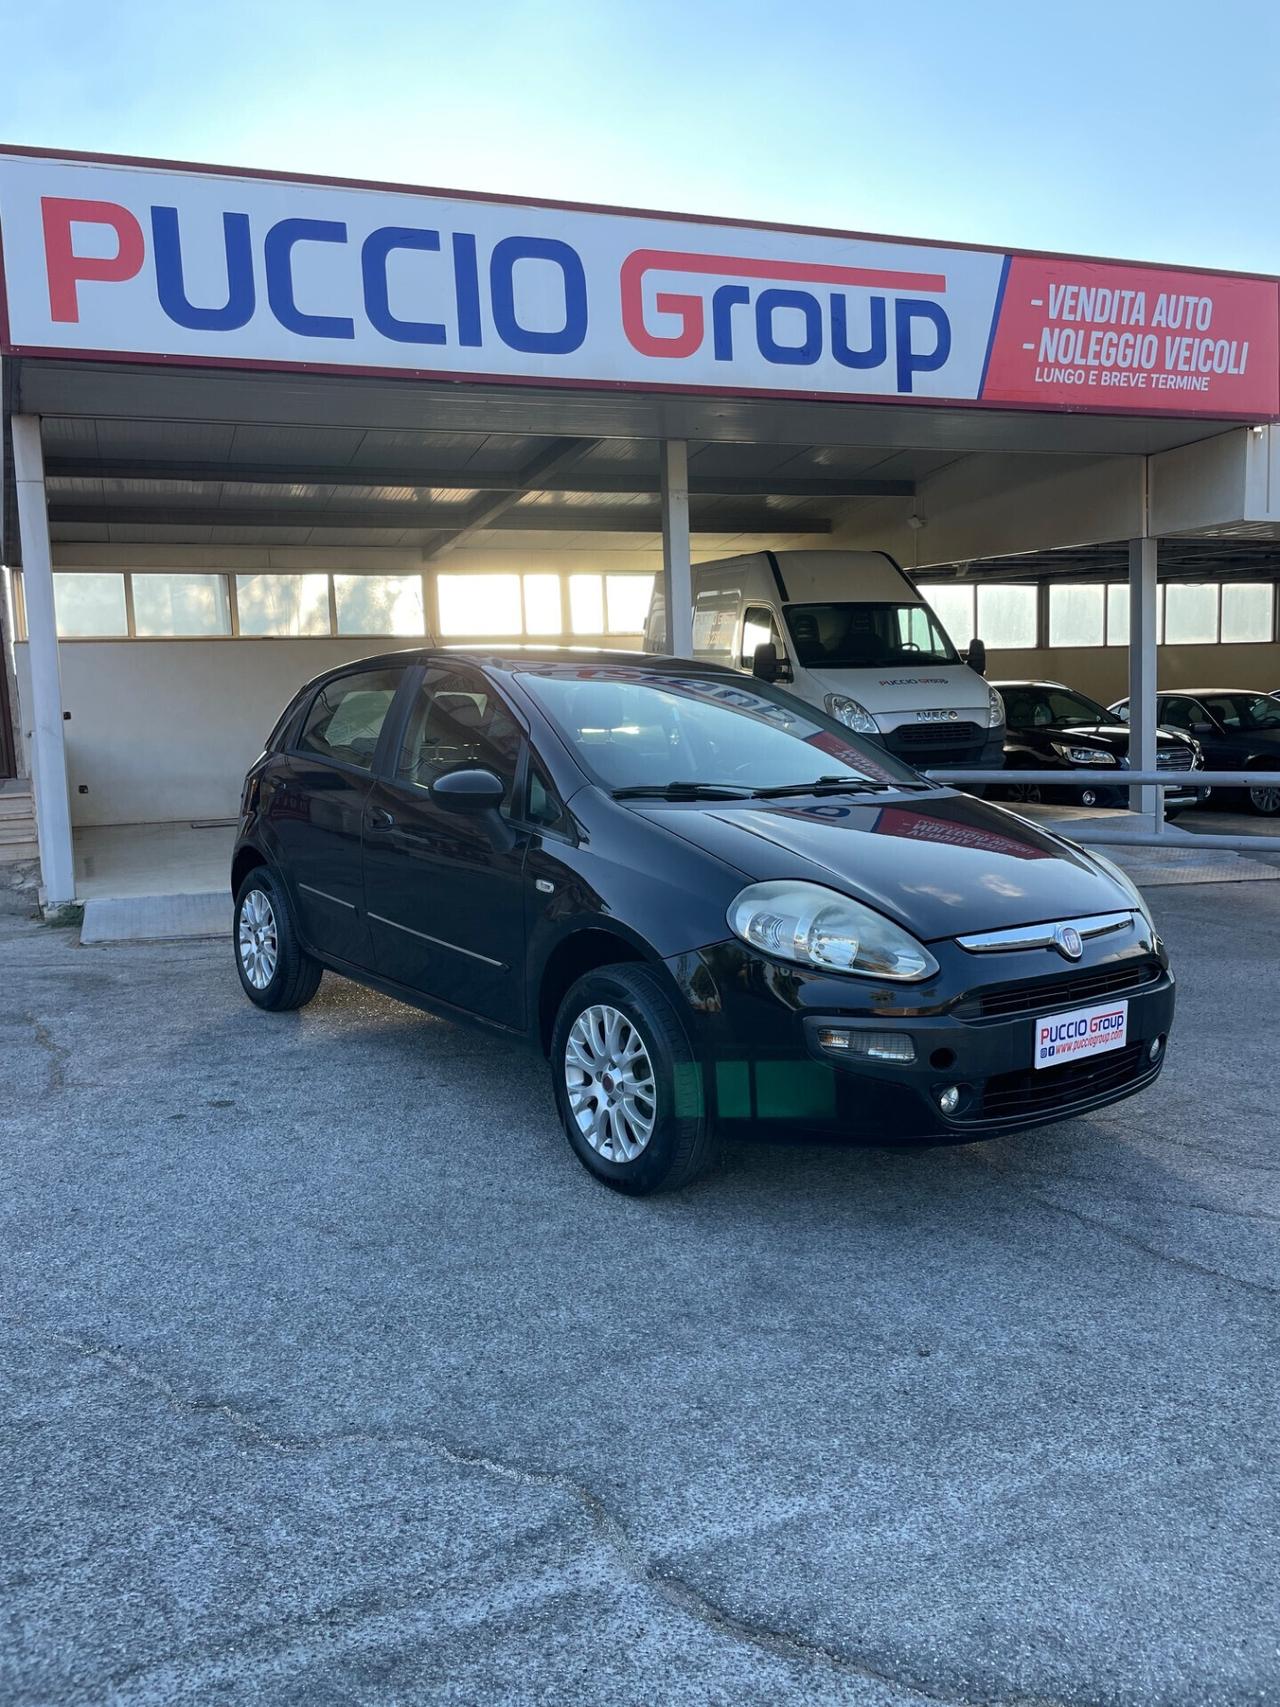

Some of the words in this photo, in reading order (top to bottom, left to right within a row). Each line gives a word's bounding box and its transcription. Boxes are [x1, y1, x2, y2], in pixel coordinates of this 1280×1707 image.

[40, 196, 588, 354] PUCCIO
[620, 248, 951, 393] Group
[1048, 284, 1146, 326] VENDITA
[1151, 293, 1213, 331] AUTO
[1038, 327, 1158, 369] NOLEGGIO
[1164, 336, 1248, 375] VEICOLI
[1035, 367, 1085, 385] LUNGO
[1088, 370, 1098, 385] E
[1100, 371, 1147, 388] BREVE
[1150, 373, 1210, 391] TERMINE
[916, 710, 958, 721] IVECO
[1040, 1019, 1087, 1045] PUCCIO
[1089, 1010, 1124, 1032] Group
[1055, 1029, 1123, 1055] www.pucciogroup.com
